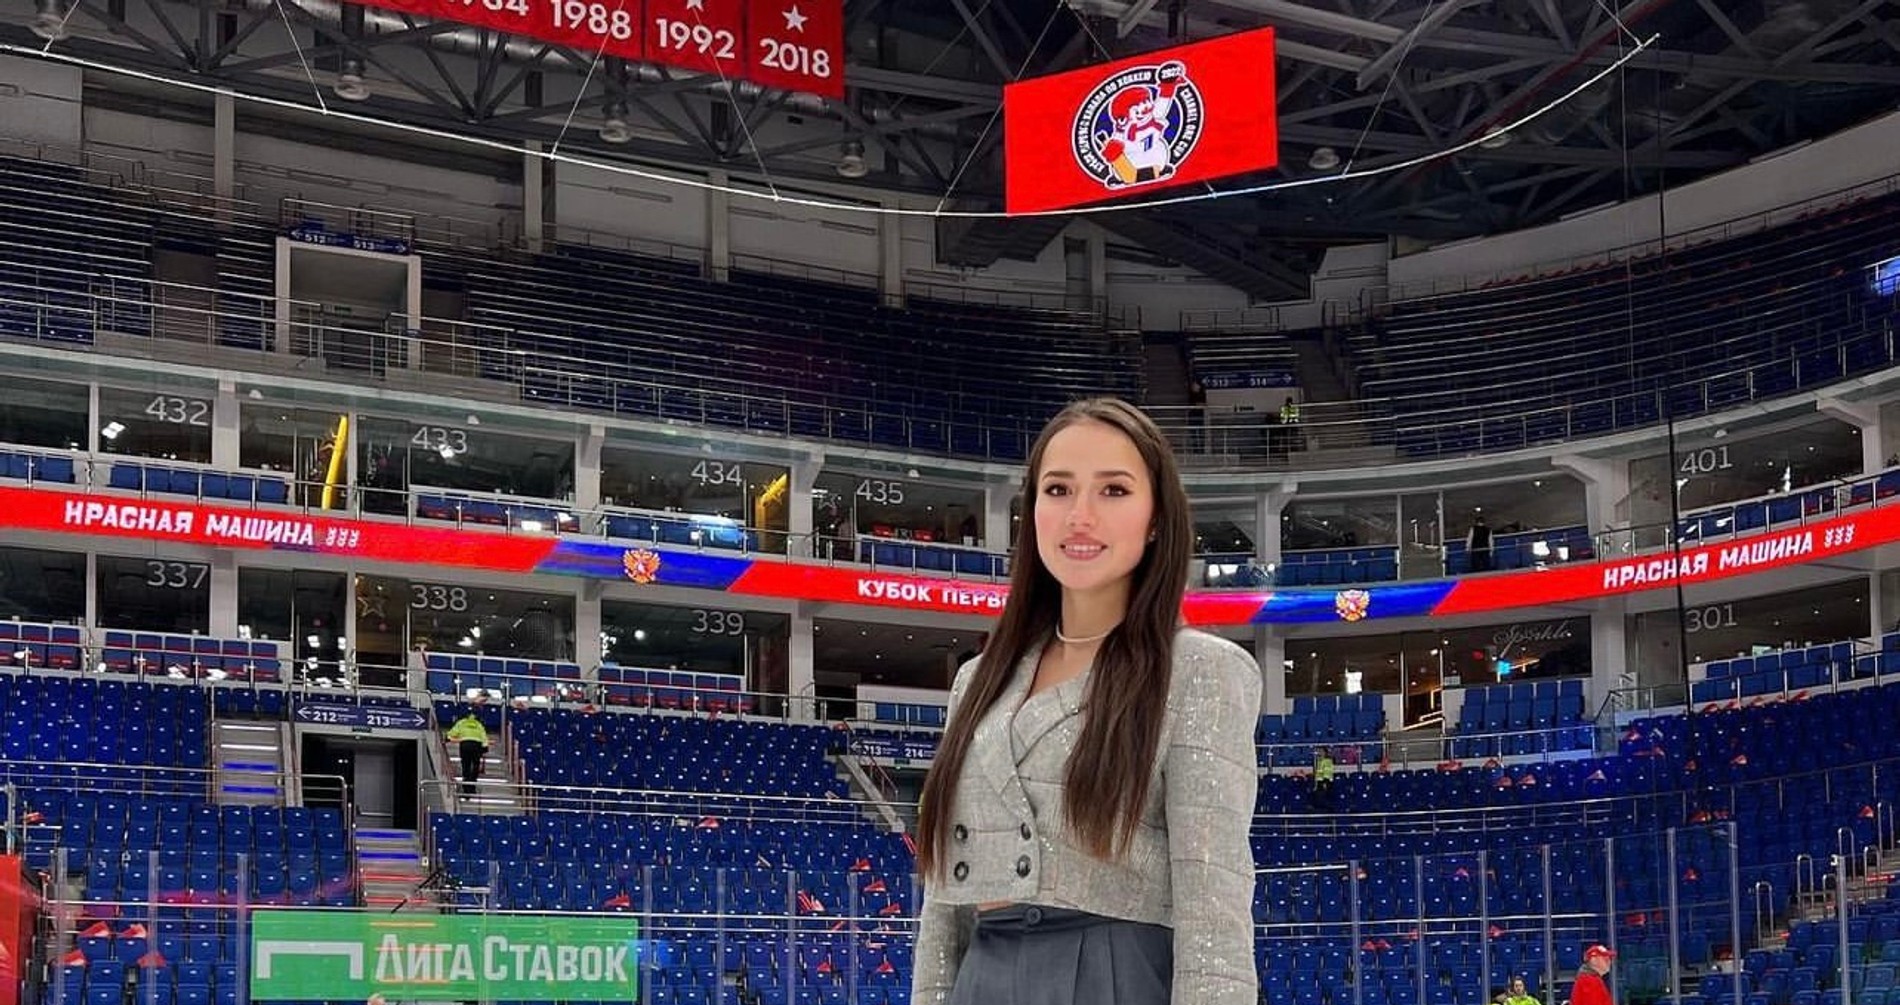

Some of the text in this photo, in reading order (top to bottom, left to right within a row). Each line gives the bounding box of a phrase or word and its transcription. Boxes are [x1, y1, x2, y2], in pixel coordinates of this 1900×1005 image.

[551, 0, 632, 40] 1988
[656, 18, 736, 60] 1992
[759, 38, 830, 79] 2018
[145, 396, 209, 427] 432
[412, 425, 468, 455] 433
[691, 460, 743, 487] 434
[1680, 446, 1734, 475] 401
[856, 479, 904, 504] 435
[205, 514, 315, 546] МАШИНА
[1719, 531, 1813, 572] МАШИНА
[146, 561, 209, 590] 337
[411, 585, 468, 612] 338
[858, 579, 1007, 609] КУБОК ПЕРВ
[692, 610, 745, 635] 339
[1685, 603, 1737, 633] 301
[313, 711, 337, 722] 212
[366, 715, 391, 726] 213
